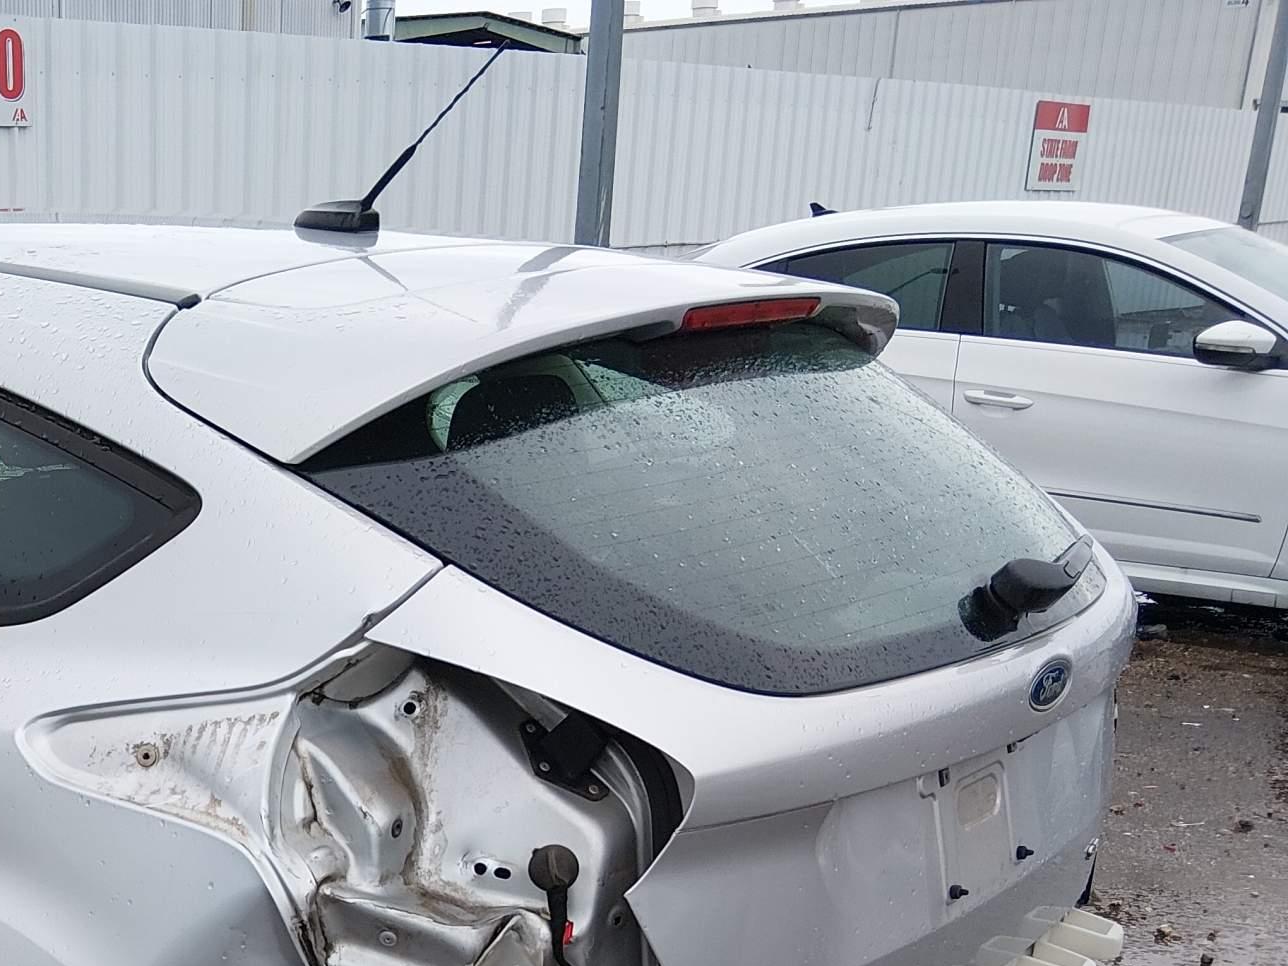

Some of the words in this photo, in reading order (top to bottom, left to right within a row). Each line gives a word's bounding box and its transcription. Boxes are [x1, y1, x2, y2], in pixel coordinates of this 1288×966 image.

[1040, 138, 1061, 158] STATE
[1058, 140, 1078, 160] FARM
[1038, 162, 1058, 182] DROP
[1056, 163, 1073, 182] ZONE
[1039, 670, 1064, 701] Ford
